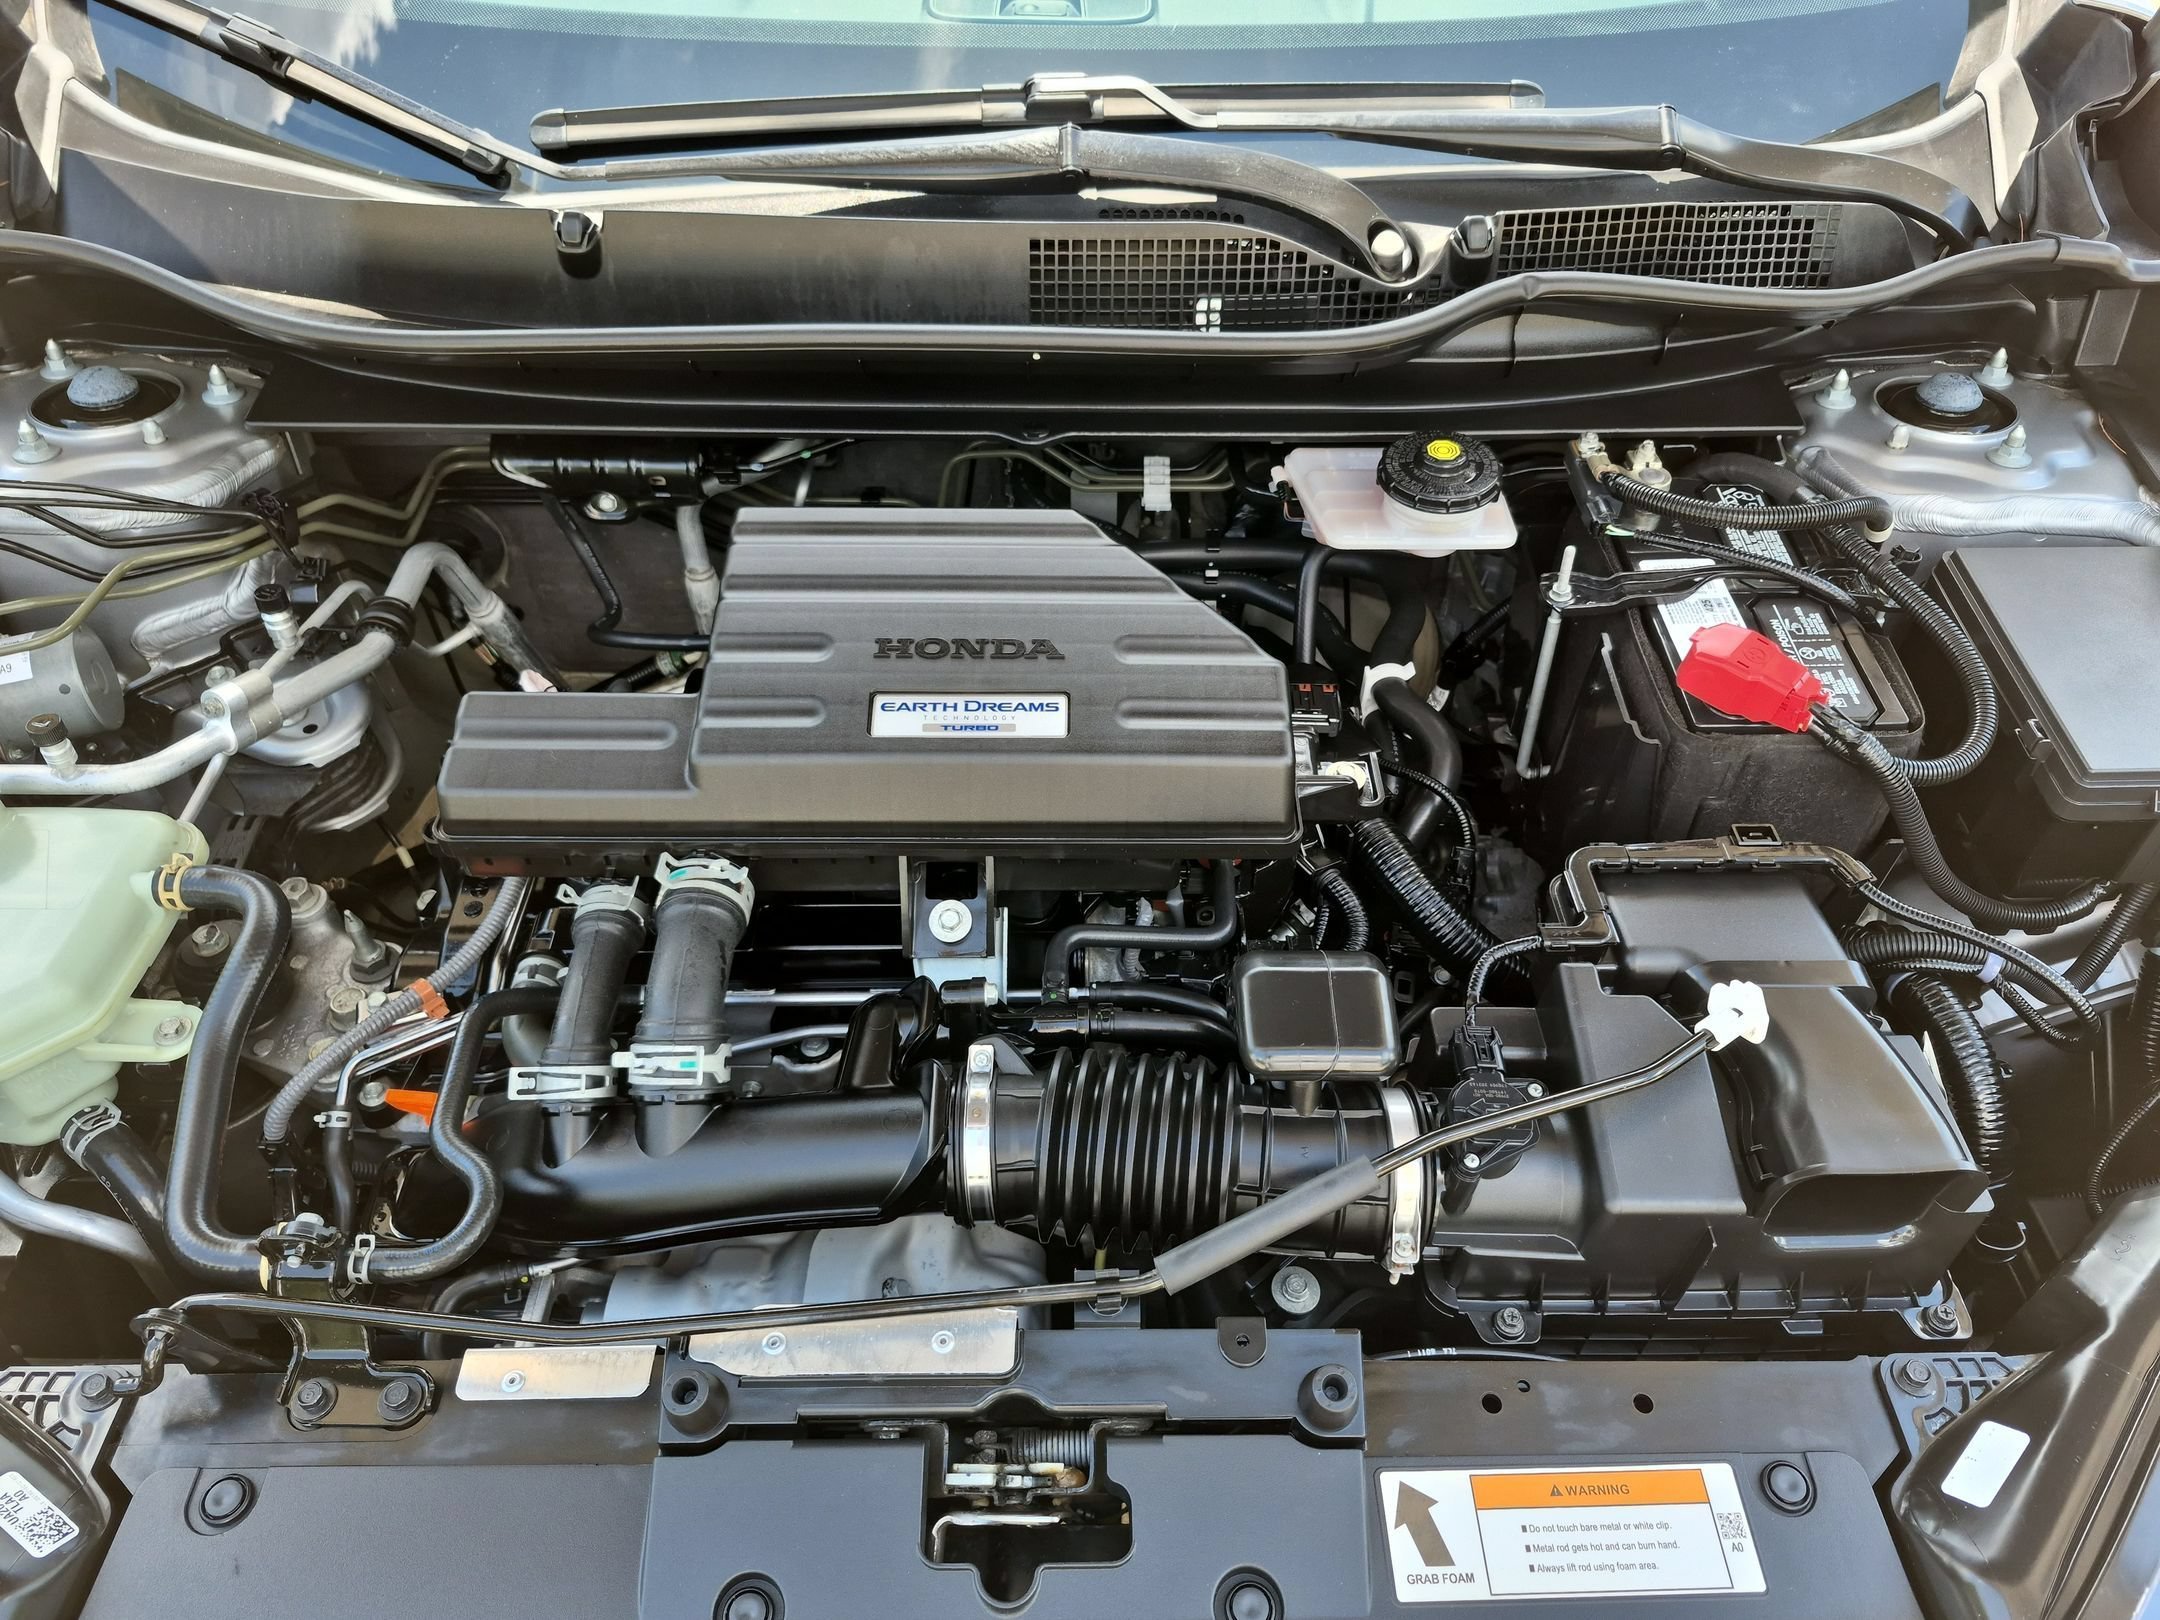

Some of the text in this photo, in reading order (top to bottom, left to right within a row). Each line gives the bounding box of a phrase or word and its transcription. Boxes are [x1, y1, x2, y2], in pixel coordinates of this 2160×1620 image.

[1769, 619, 1792, 647] POISON
[873, 637, 1066, 660] HONDA
[880, 700, 1060, 712] EARTH DREAMS
[1564, 1484, 1630, 1496] WARNING
[1528, 1524, 1541, 1533] Do
[1542, 1524, 1556, 1532] not
[1557, 1523, 1579, 1532] touch
[1580, 1523, 1598, 1532] bare
[1600, 1522, 1621, 1531] metal
[1633, 1521, 1654, 1530] white
[1656, 1521, 1672, 1531] clip.
[1532, 1544, 1555, 1552] Metal
[1557, 1543, 1570, 1552] rod
[1571, 1543, 1589, 1554] gets
[1590, 1542, 1603, 1551] hot
[1605, 1542, 1620, 1551] and
[1637, 1541, 1656, 1550] burn
[1657, 1540, 1680, 1549] hand.
[1732, 1542, 1744, 1553] A0
[1537, 1561, 1660, 1574] Always lift rod using foam area.
[1406, 1572, 1475, 1585] GRAB FOAM
